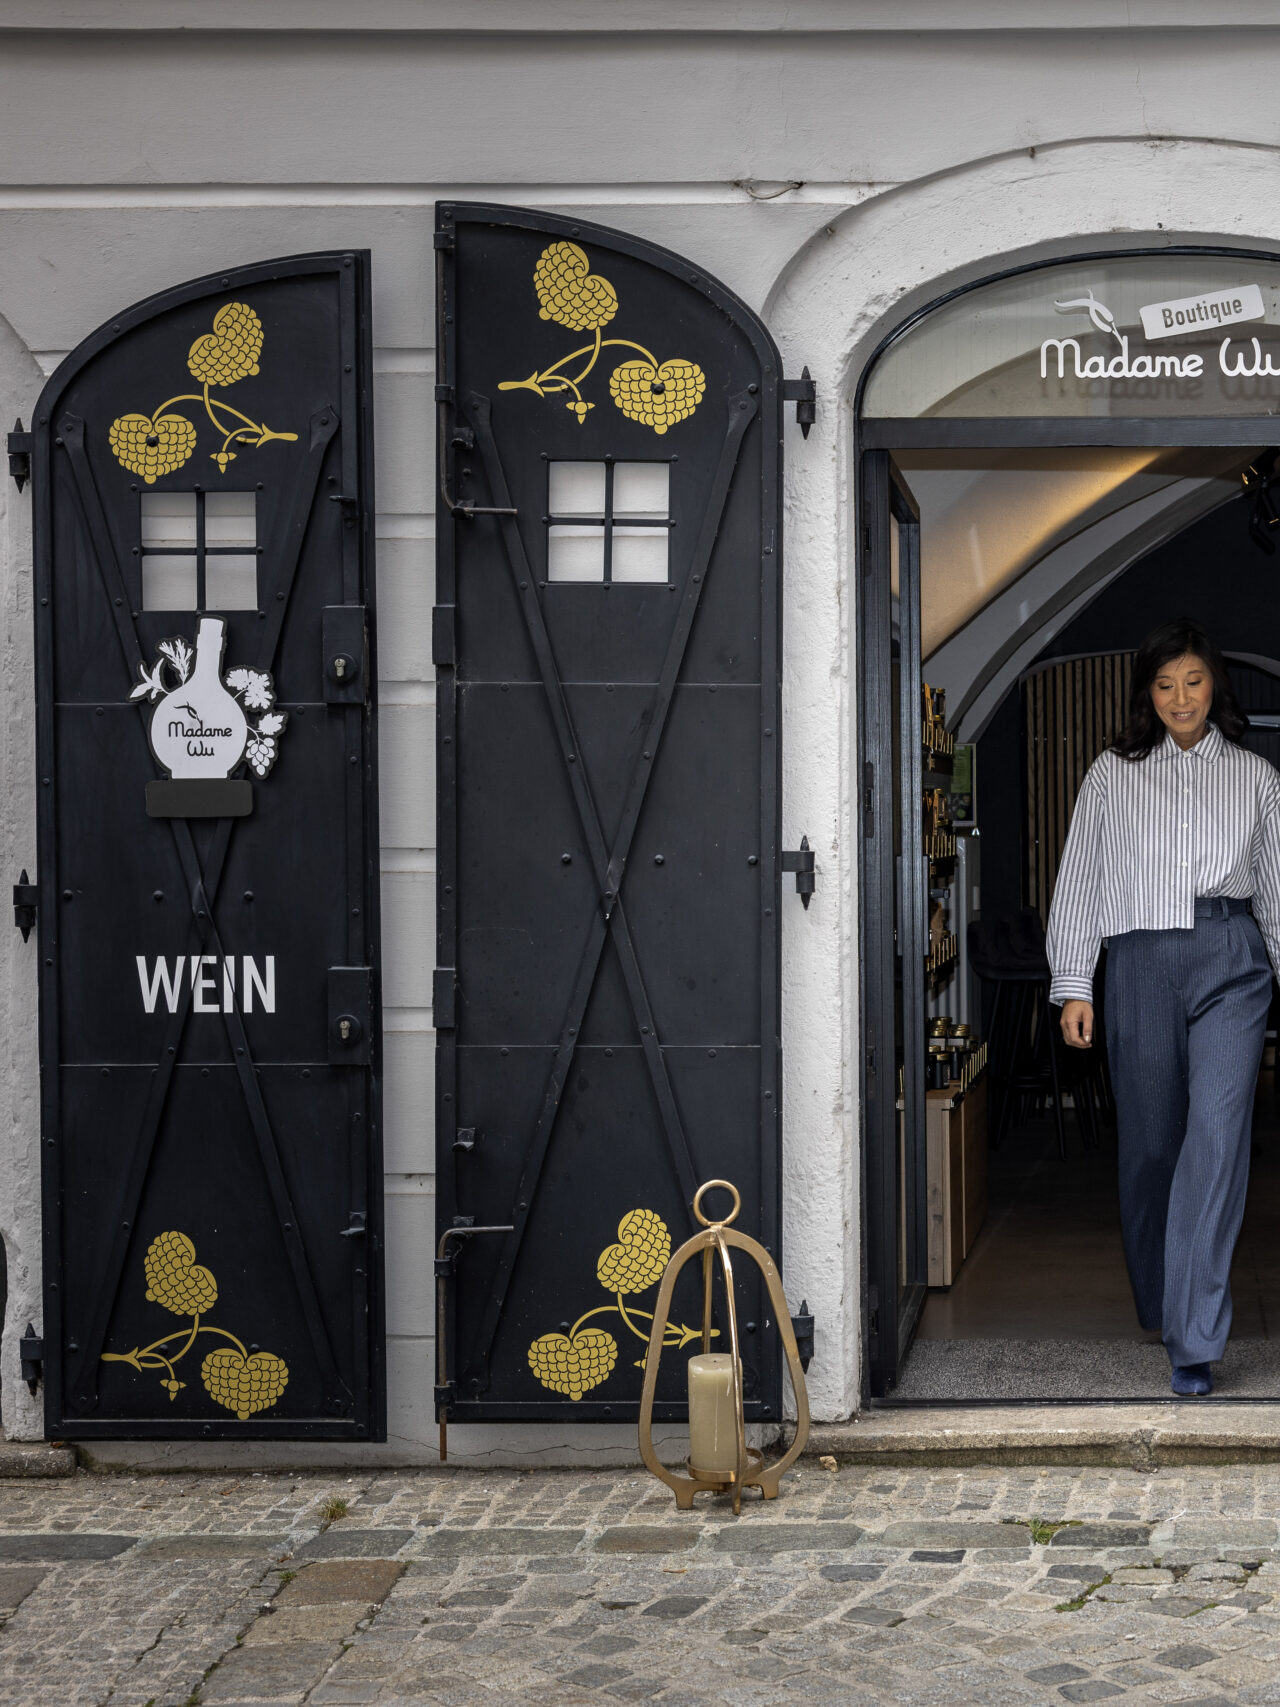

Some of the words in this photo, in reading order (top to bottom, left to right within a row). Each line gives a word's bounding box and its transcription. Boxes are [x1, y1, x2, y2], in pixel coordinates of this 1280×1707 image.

[1161, 298, 1243, 329] Boutique
[1040, 336, 1204, 378] Madame
[168, 720, 232, 738] Madame
[187, 740, 215, 757] Wu
[135, 955, 276, 1014] WEIN
